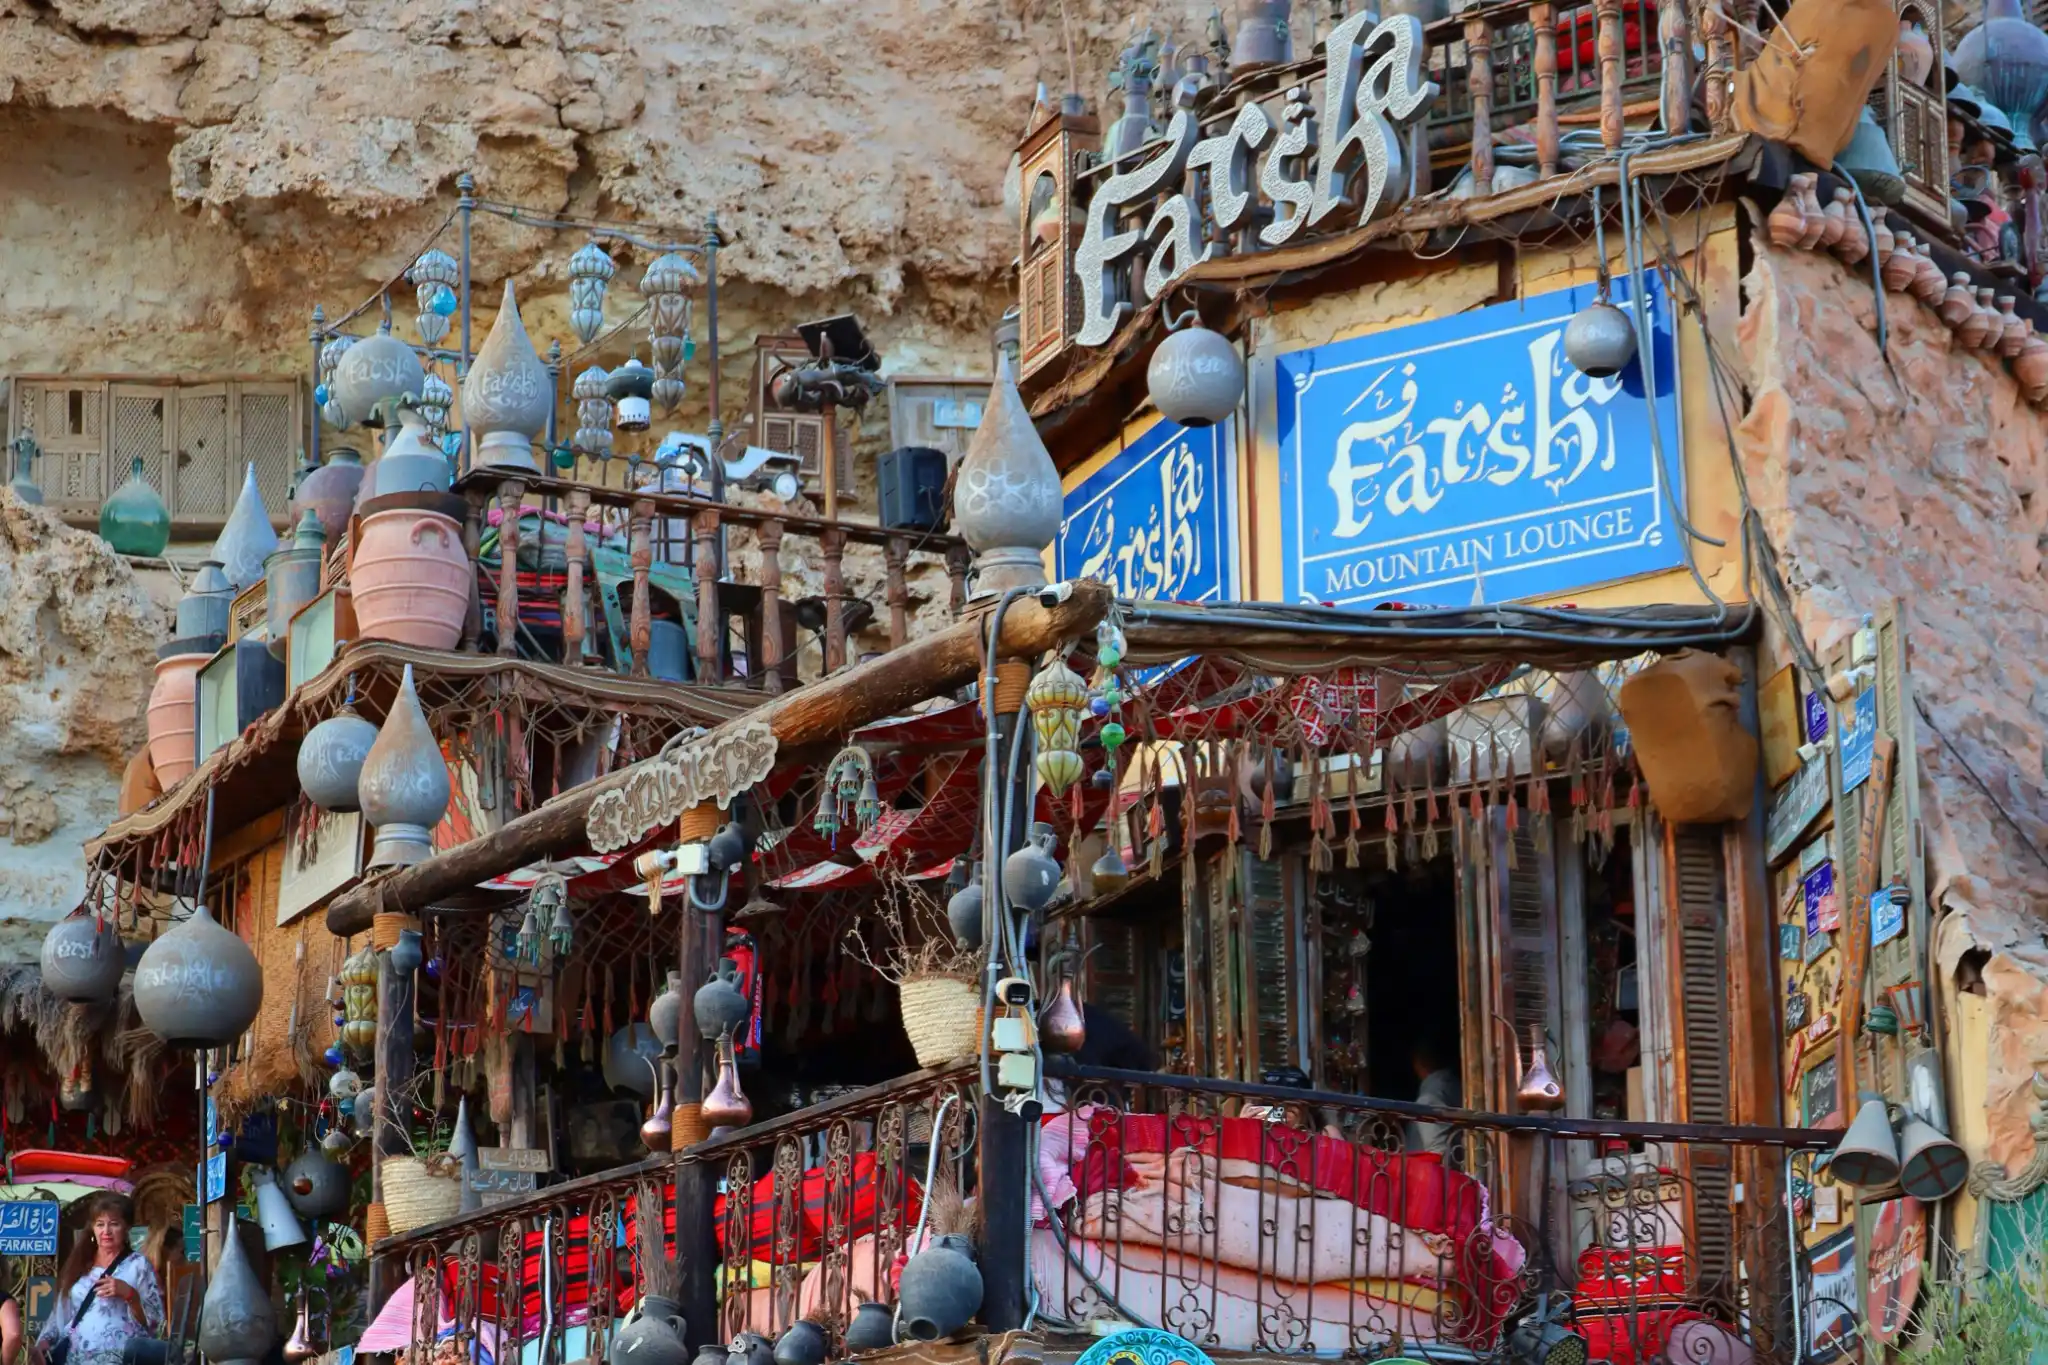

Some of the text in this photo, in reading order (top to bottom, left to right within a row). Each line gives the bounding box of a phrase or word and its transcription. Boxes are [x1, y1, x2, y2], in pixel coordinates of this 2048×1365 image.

[1075, 10, 1439, 347] Farsha
[1080, 442, 1204, 601] rsha
[1324, 506, 1635, 595] MOUNTAIN LOUNGE
[0, 1239, 52, 1252] FARAKEN
